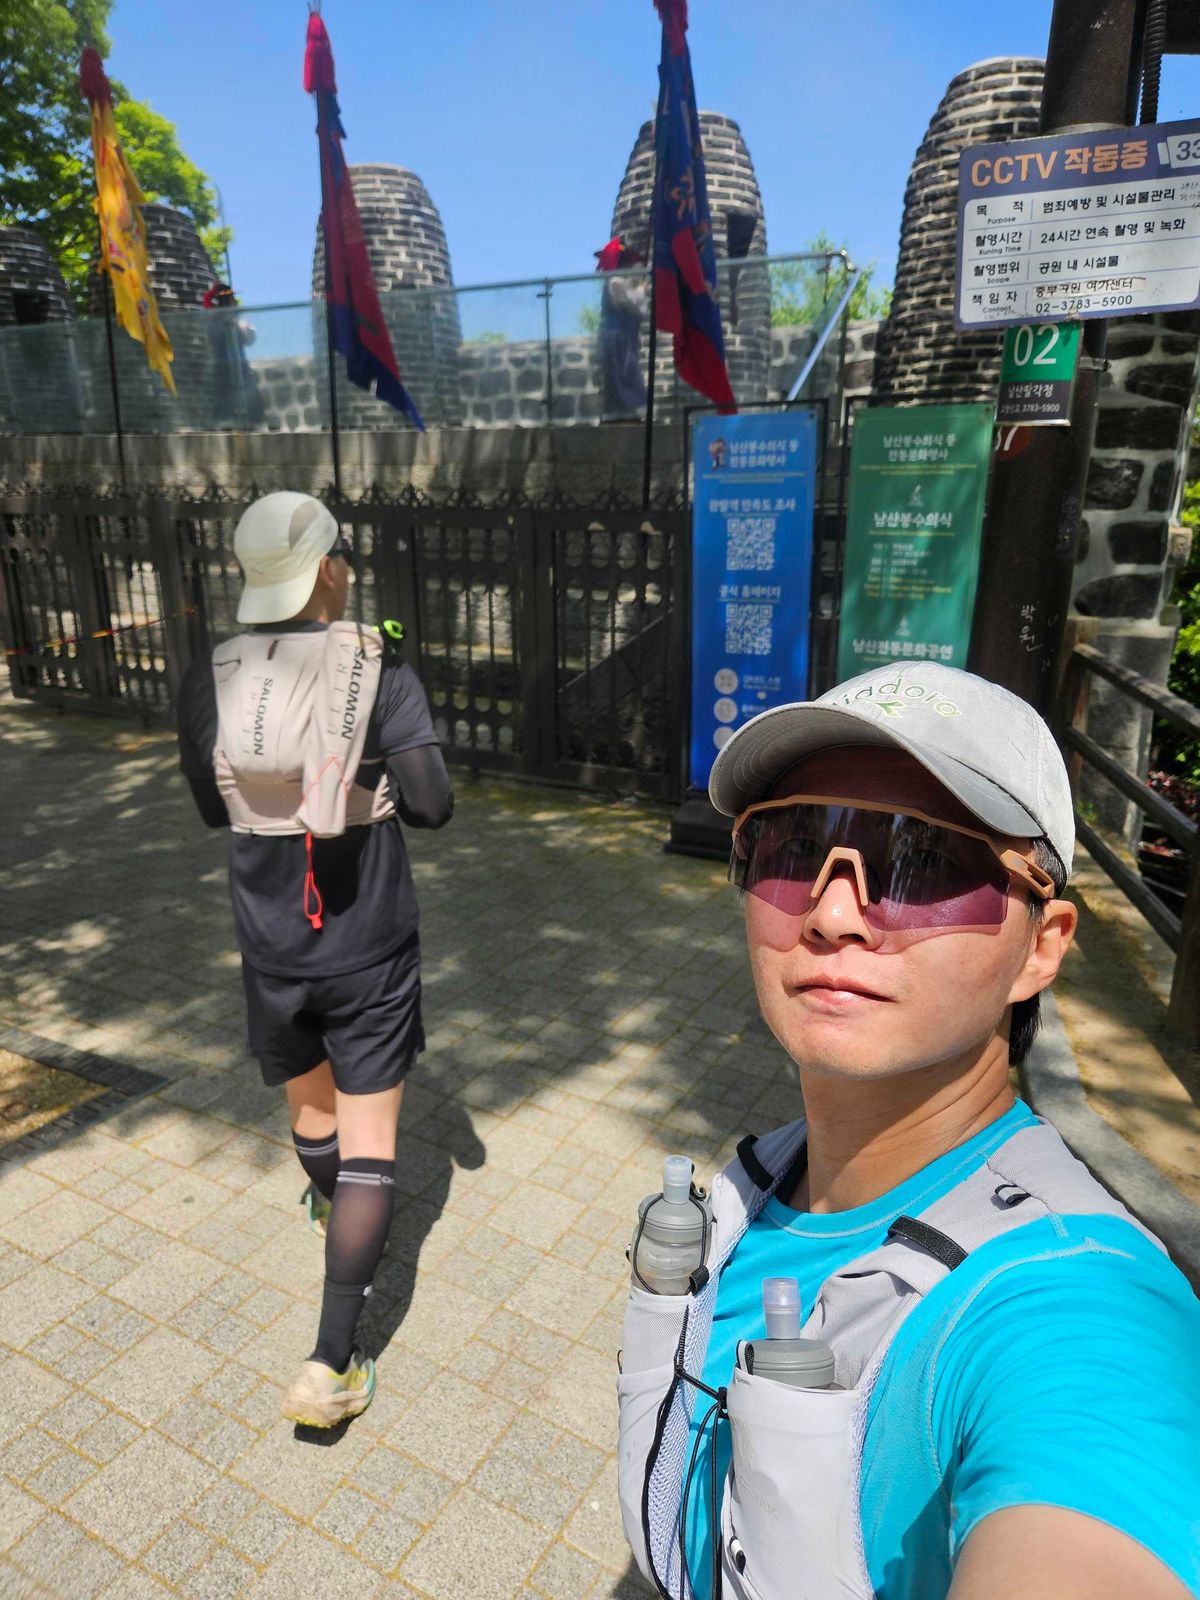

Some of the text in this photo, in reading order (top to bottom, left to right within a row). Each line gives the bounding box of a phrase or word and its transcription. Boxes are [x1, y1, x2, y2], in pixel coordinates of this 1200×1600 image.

[971, 140, 1148, 187] CCTV 작동중
[1043, 199, 1091, 214] 범죄예방
[1097, 196, 1108, 208] 및
[1113, 188, 1175, 206] 시설물관리
[987, 216, 1016, 225] Purpose
[1041, 218, 1186, 244] 24시간 연속 촬영 및 녹화
[975, 231, 1022, 247] 촬영시간
[979, 247, 1003, 256] Runing
[974, 261, 1020, 276] 촬영범위
[1039, 255, 1119, 274] 공원 내 시설물
[987, 277, 1010, 285] Scope
[1035, 295, 1133, 314] 02-3783-5900
[1013, 324, 1060, 366] 02
[341, 645, 366, 740] SALOMON
[832, 678, 961, 717] iadora
[254, 677, 274, 756] SALOMON
